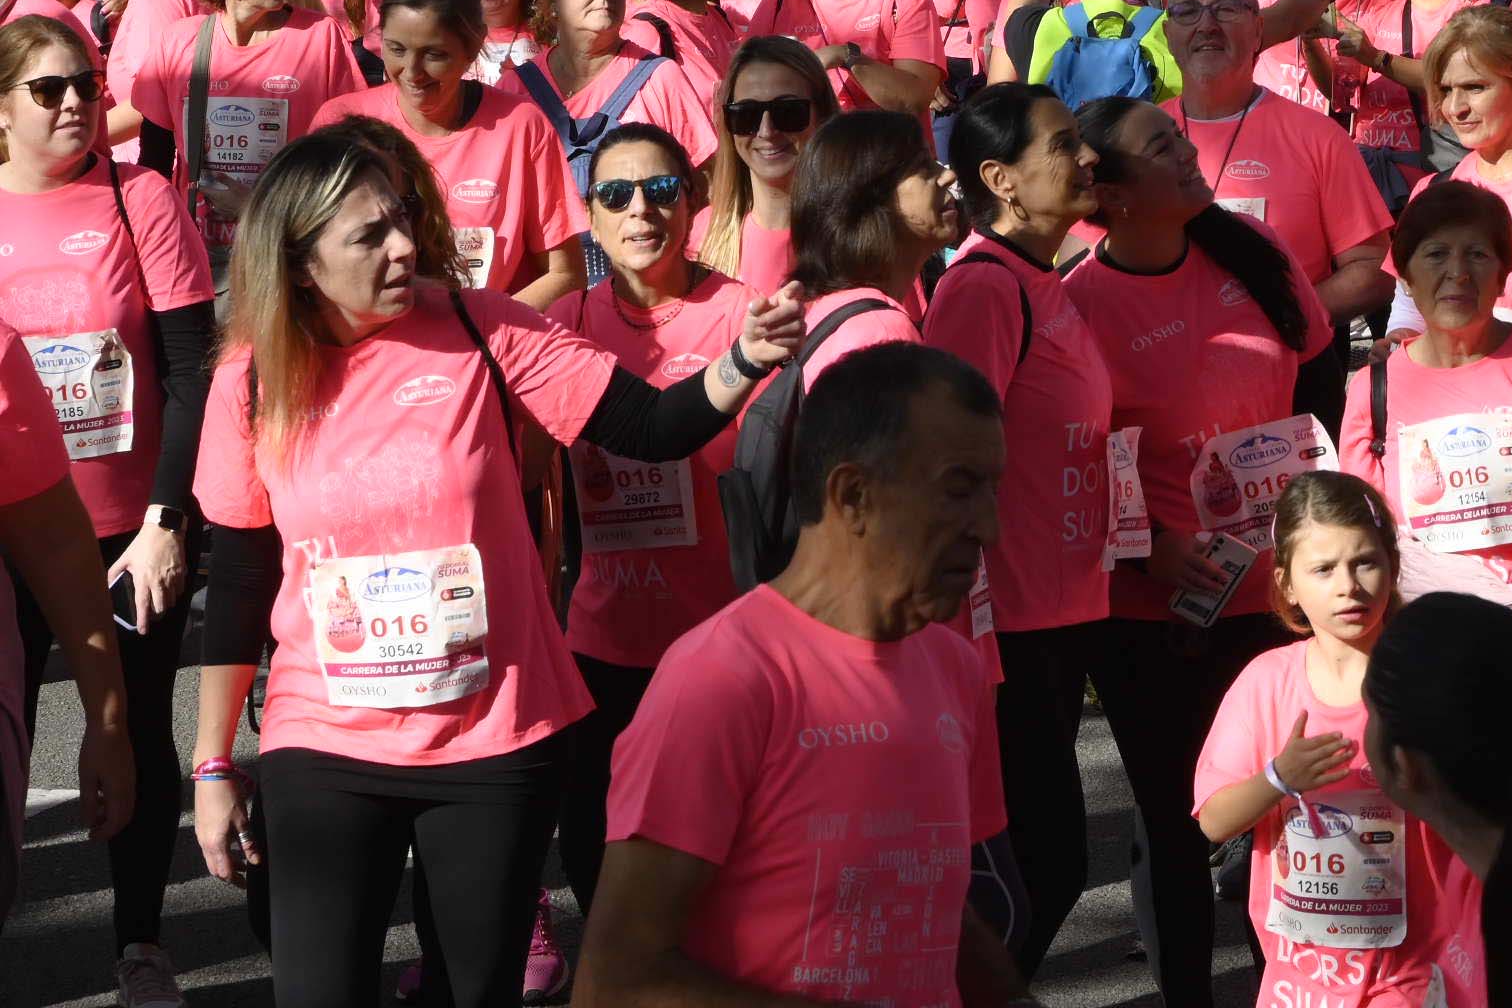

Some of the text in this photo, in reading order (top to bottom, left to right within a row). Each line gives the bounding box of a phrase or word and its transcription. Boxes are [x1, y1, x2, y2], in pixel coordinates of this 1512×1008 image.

[214, 113, 251, 122] ASTURIANA
[214, 135, 249, 148] 016
[217, 152, 244, 161] 14182
[1131, 319, 1186, 352] OYSHO
[36, 356, 86, 369] ASTURIANA
[1064, 420, 1098, 452] TU
[1235, 445, 1288, 465] ASTURIANA
[616, 467, 663, 488] 016
[1450, 466, 1489, 488] 016
[624, 492, 660, 505] 29872
[1459, 490, 1486, 505] 12154
[1424, 513, 1462, 525] CARRERA
[437, 567, 469, 578] SUMA
[365, 580, 427, 596] ASTURIANA
[371, 614, 428, 638] 016
[379, 642, 424, 658] 30542
[341, 660, 449, 675] CARRERA DE LA MUJER
[341, 684, 387, 698] OYSHO
[798, 720, 889, 749] OYSHO
[1360, 809, 1392, 821] SUMA
[1293, 850, 1345, 875] 016
[1298, 879, 1339, 895] 12156
[1301, 900, 1389, 913] DE LA MUJER 2023
[1340, 923, 1394, 935] Santander
[793, 966, 869, 983] BARCELONA
